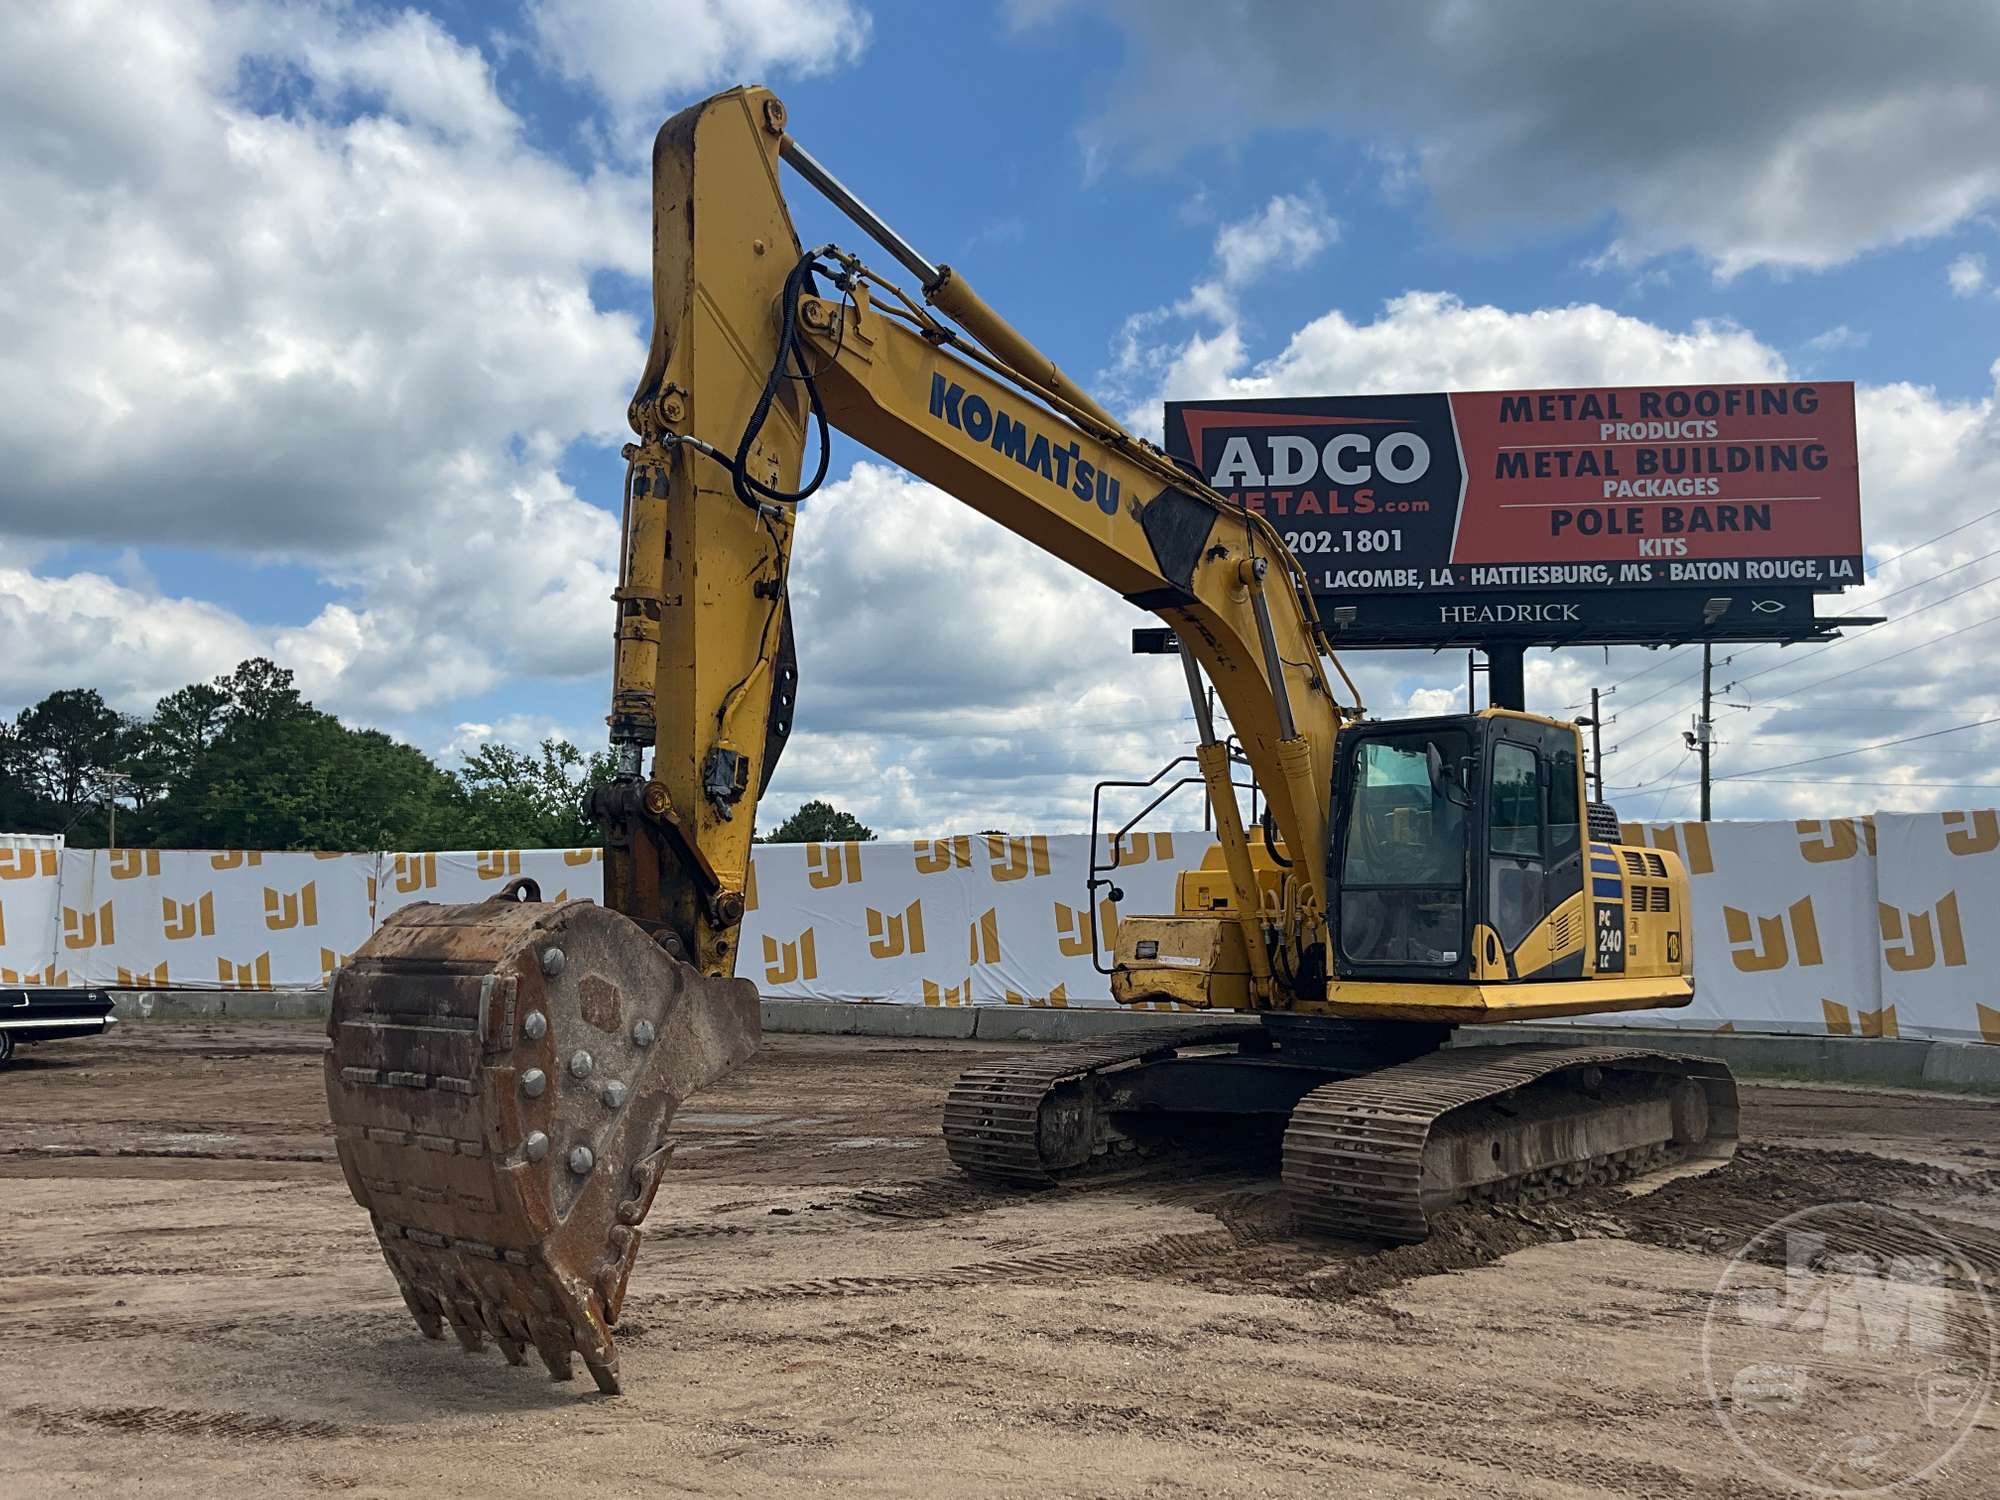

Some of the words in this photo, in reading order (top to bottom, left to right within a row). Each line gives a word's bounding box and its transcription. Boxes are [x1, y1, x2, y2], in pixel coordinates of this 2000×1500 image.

[1500, 393, 1623, 423] METAL
[1640, 387, 1819, 419] ROOFING
[1600, 420, 1718, 441] PRODUCTS
[929, 372, 1120, 515] KOMATSU
[1211, 431, 1431, 488] ADCO
[1496, 449, 1622, 479] METAL
[1636, 444, 1829, 475] BUILDING
[1603, 477, 1720, 498] PACKAGES
[1551, 508, 1644, 536] POLE
[1662, 504, 1772, 533] BARN
[1639, 537, 1688, 557] KITS
[1325, 569, 1424, 590] LACOMBE,
[1430, 568, 1453, 586] LA
[1471, 564, 1614, 586] HATTIESBURG,
[1620, 564, 1652, 582] MS
[1669, 562, 1739, 581] BATON
[1746, 560, 1823, 581] ROUGE,
[1829, 559, 1853, 577] LA
[1440, 604, 1580, 624] HEADRICK
[1599, 910, 1611, 926] PC
[1600, 929, 1622, 952] 240
[1600, 954, 1610, 968] LC
